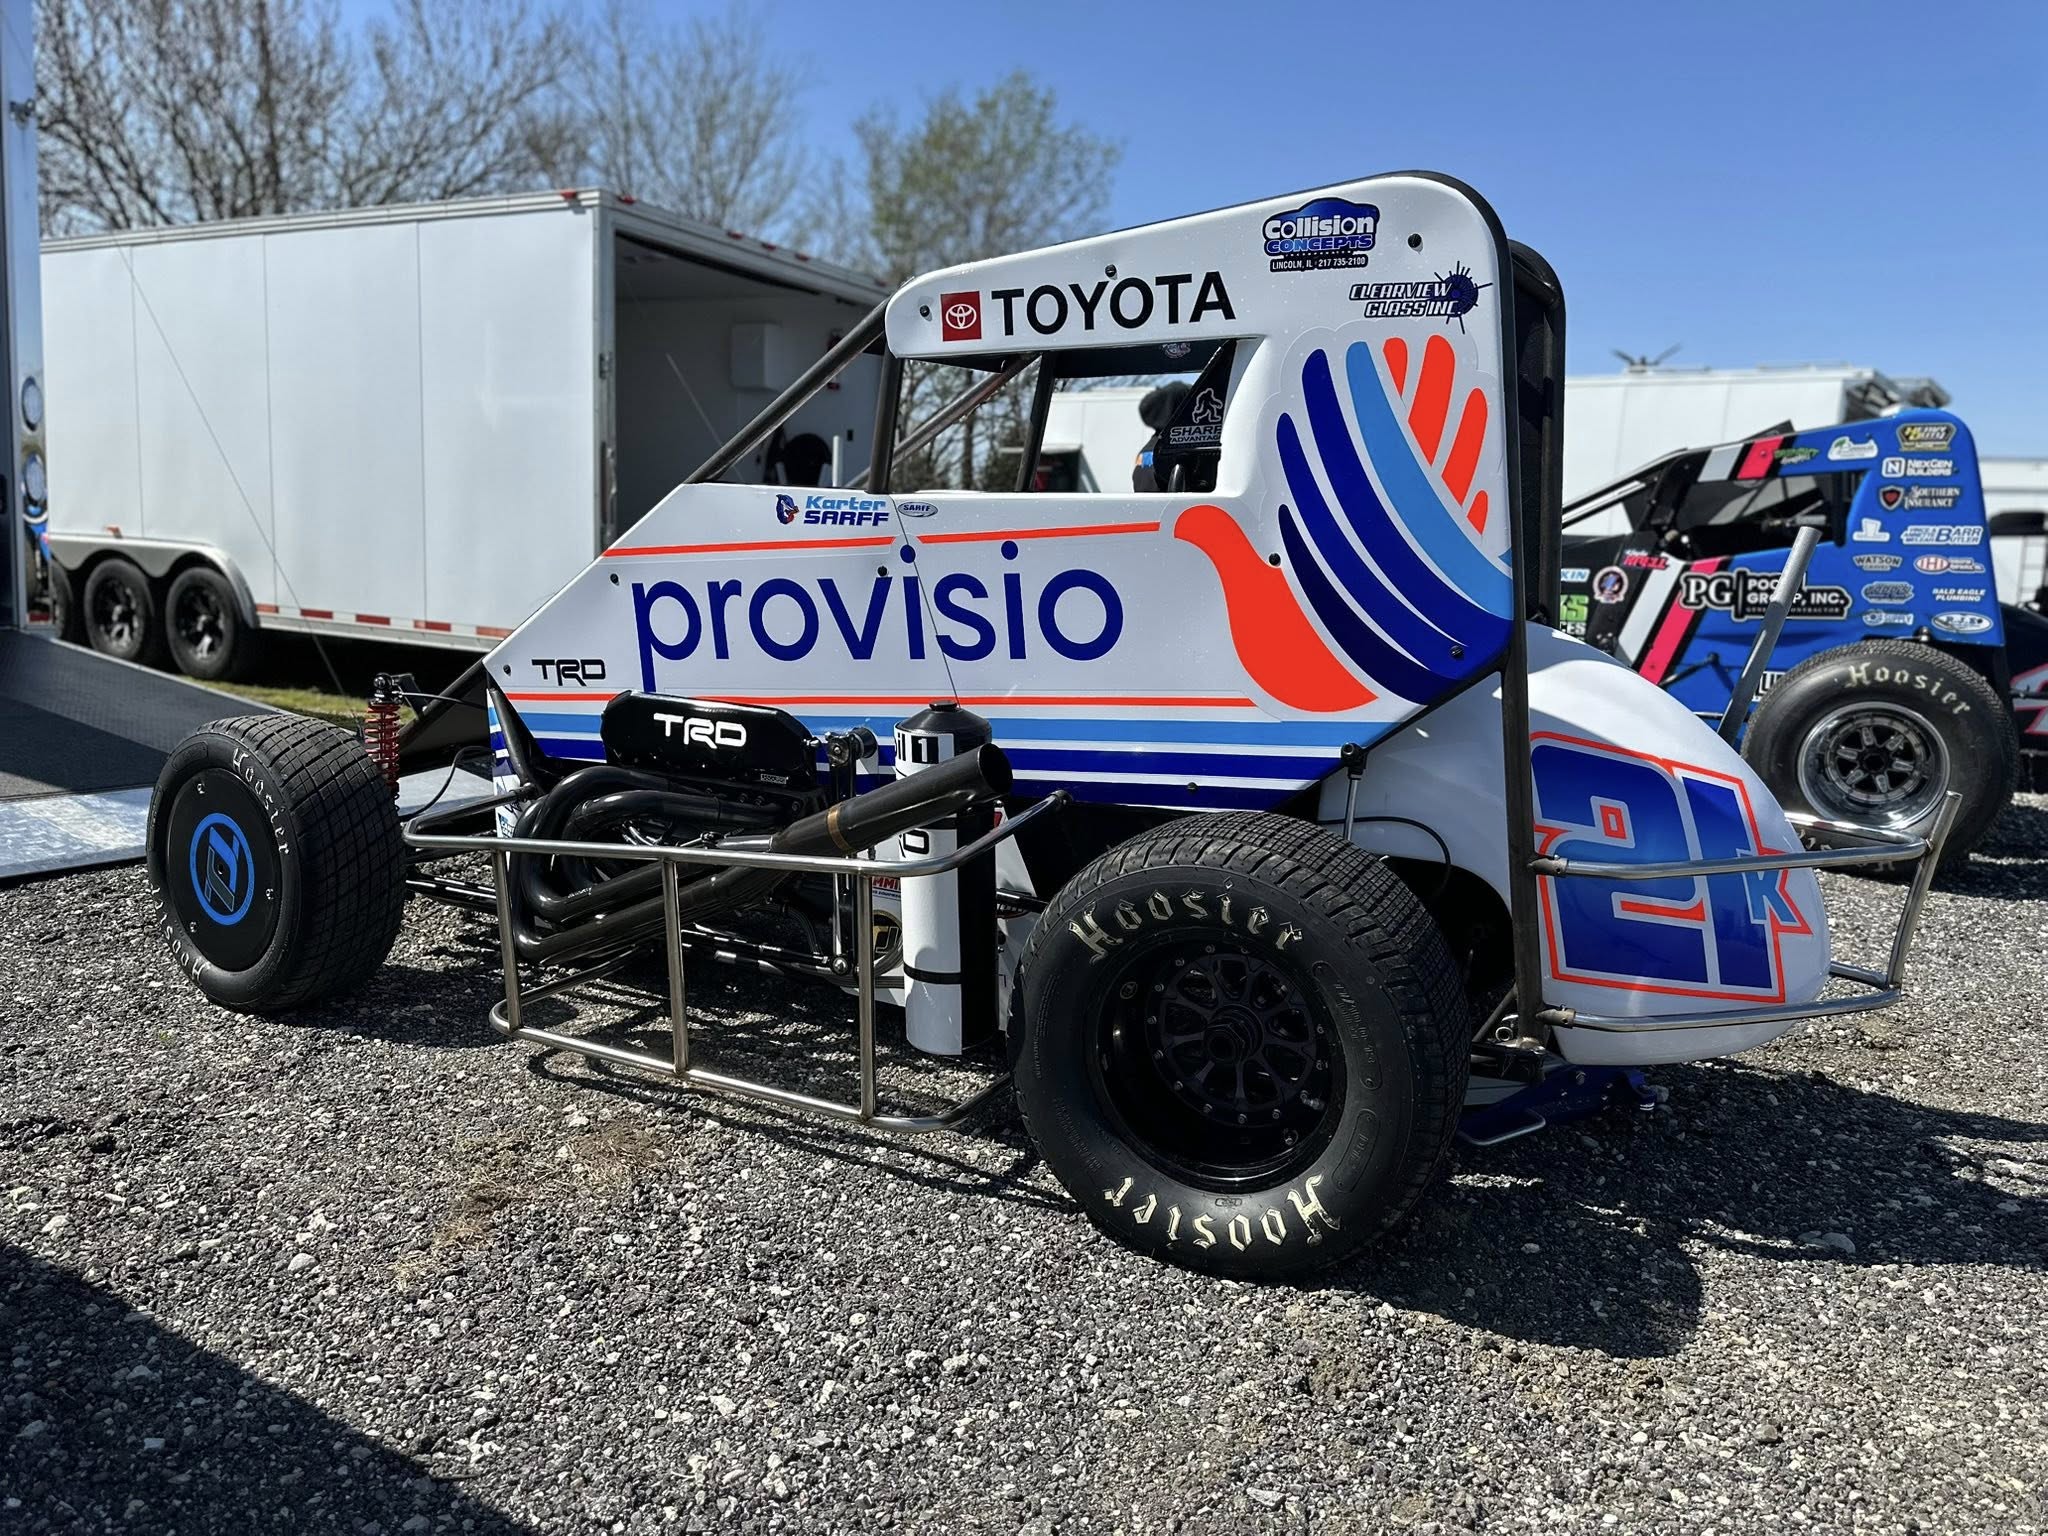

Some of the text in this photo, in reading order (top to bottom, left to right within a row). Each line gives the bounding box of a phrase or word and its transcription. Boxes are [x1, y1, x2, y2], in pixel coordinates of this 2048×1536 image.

[1265, 215, 1374, 239] Collision
[1267, 234, 1373, 254] CONCEPTS
[1272, 256, 1366, 270] LINCOLN, IL 217 735-2100
[1351, 282, 1453, 299] CLEARVIEW
[991, 270, 1237, 336] TOYOTA
[1365, 300, 1461, 317] GLASS INC.
[1171, 434, 1221, 443] ADVANTAG
[806, 495, 886, 511] Karter
[803, 509, 889, 527] SARFF
[1856, 555, 1900, 566] WATSON
[1561, 570, 1587, 580] KIN
[1748, 578, 1780, 590] POO
[1686, 578, 1733, 603] PG
[1810, 592, 1845, 604] INC.
[1957, 588, 1986, 596] EAGLE
[632, 541, 1124, 692] provisio
[531, 658, 606, 687] TRD
[1845, 661, 1971, 715] Hoosier
[653, 711, 747, 749] TRD
[233, 748, 289, 854] Hoosier
[1069, 877, 1303, 965] Hoosier
[1104, 1175, 1341, 1251] Hoosier
